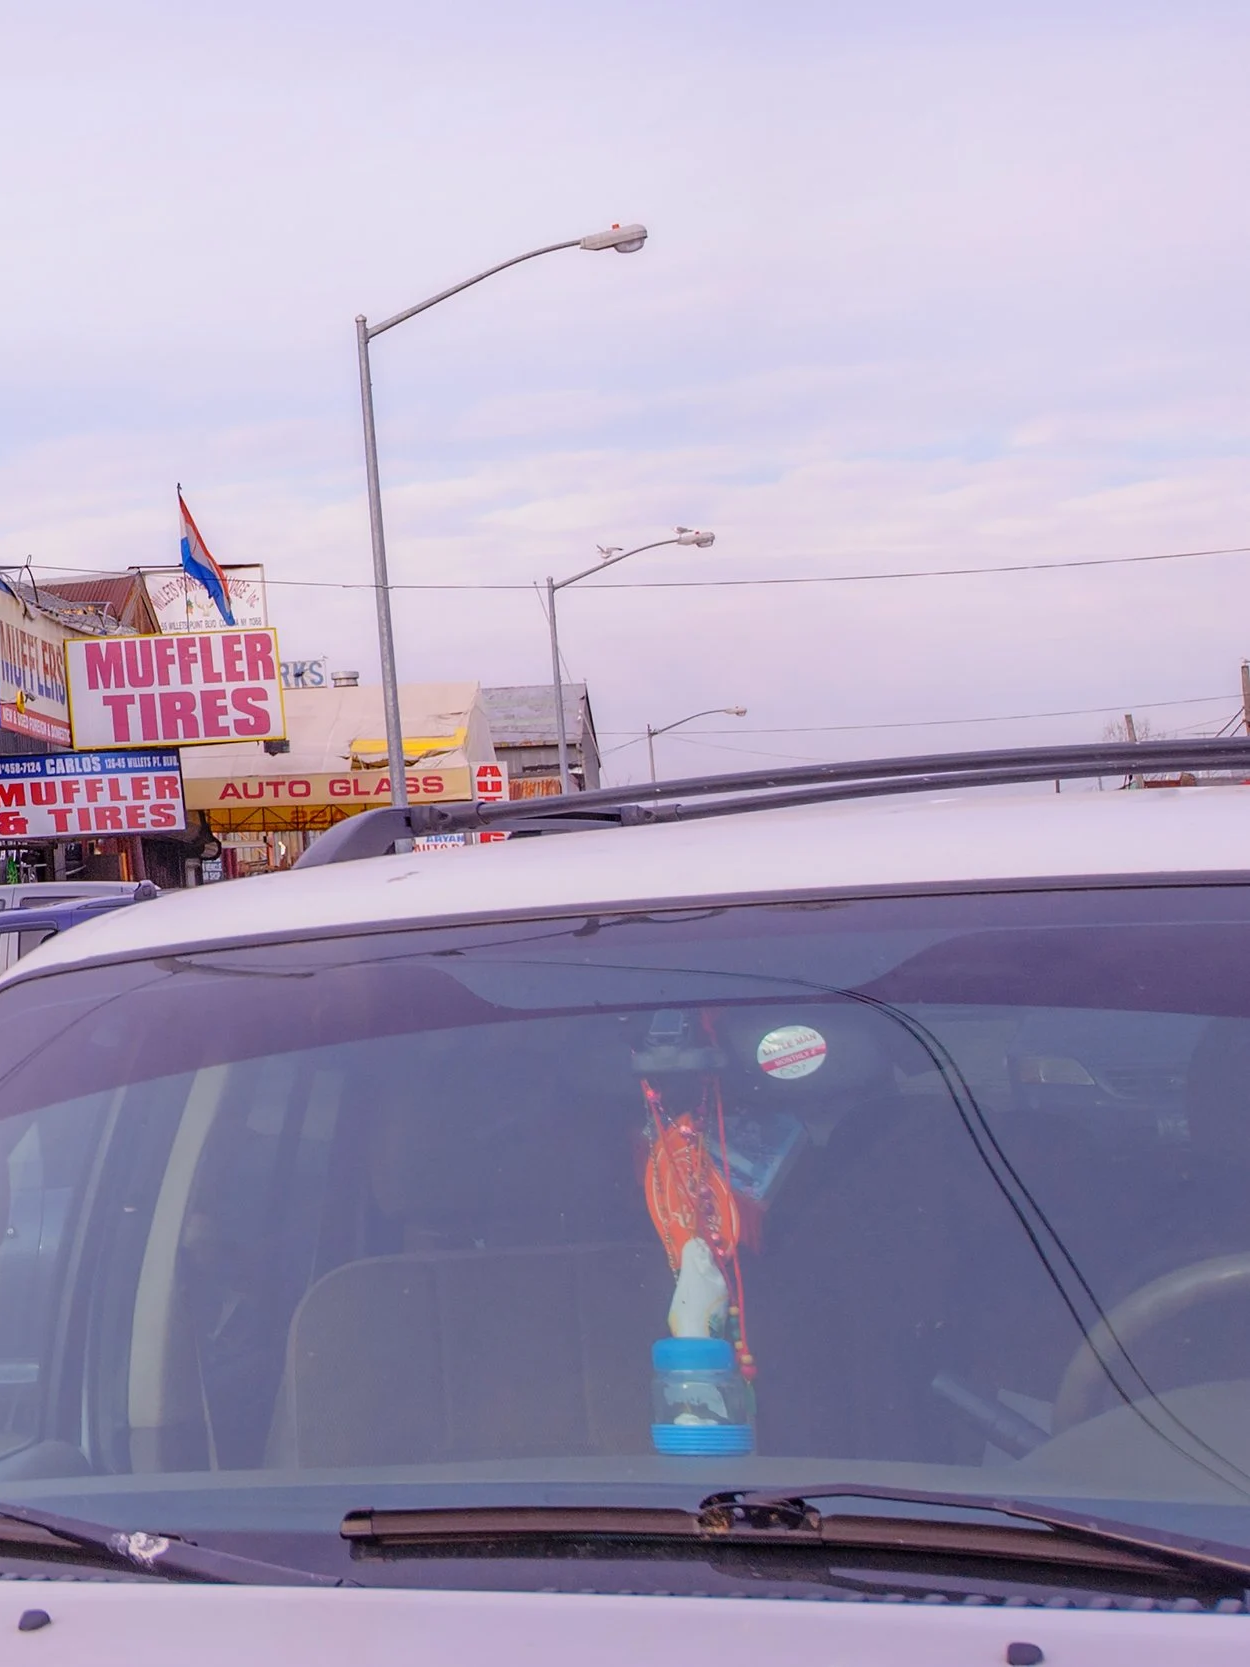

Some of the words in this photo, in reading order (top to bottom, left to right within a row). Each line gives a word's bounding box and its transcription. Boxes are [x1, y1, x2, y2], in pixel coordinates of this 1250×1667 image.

[0, 619, 66, 706] MUFFLERS
[85, 633, 276, 690] MUFFLER
[103, 687, 271, 742] TIRES
[46, 754, 102, 775] CARLO'S
[127, 756, 151, 768] WILLETS
[219, 779, 311, 800] AUTO
[329, 775, 444, 796] GLASS
[48, 803, 176, 833] TIRES
